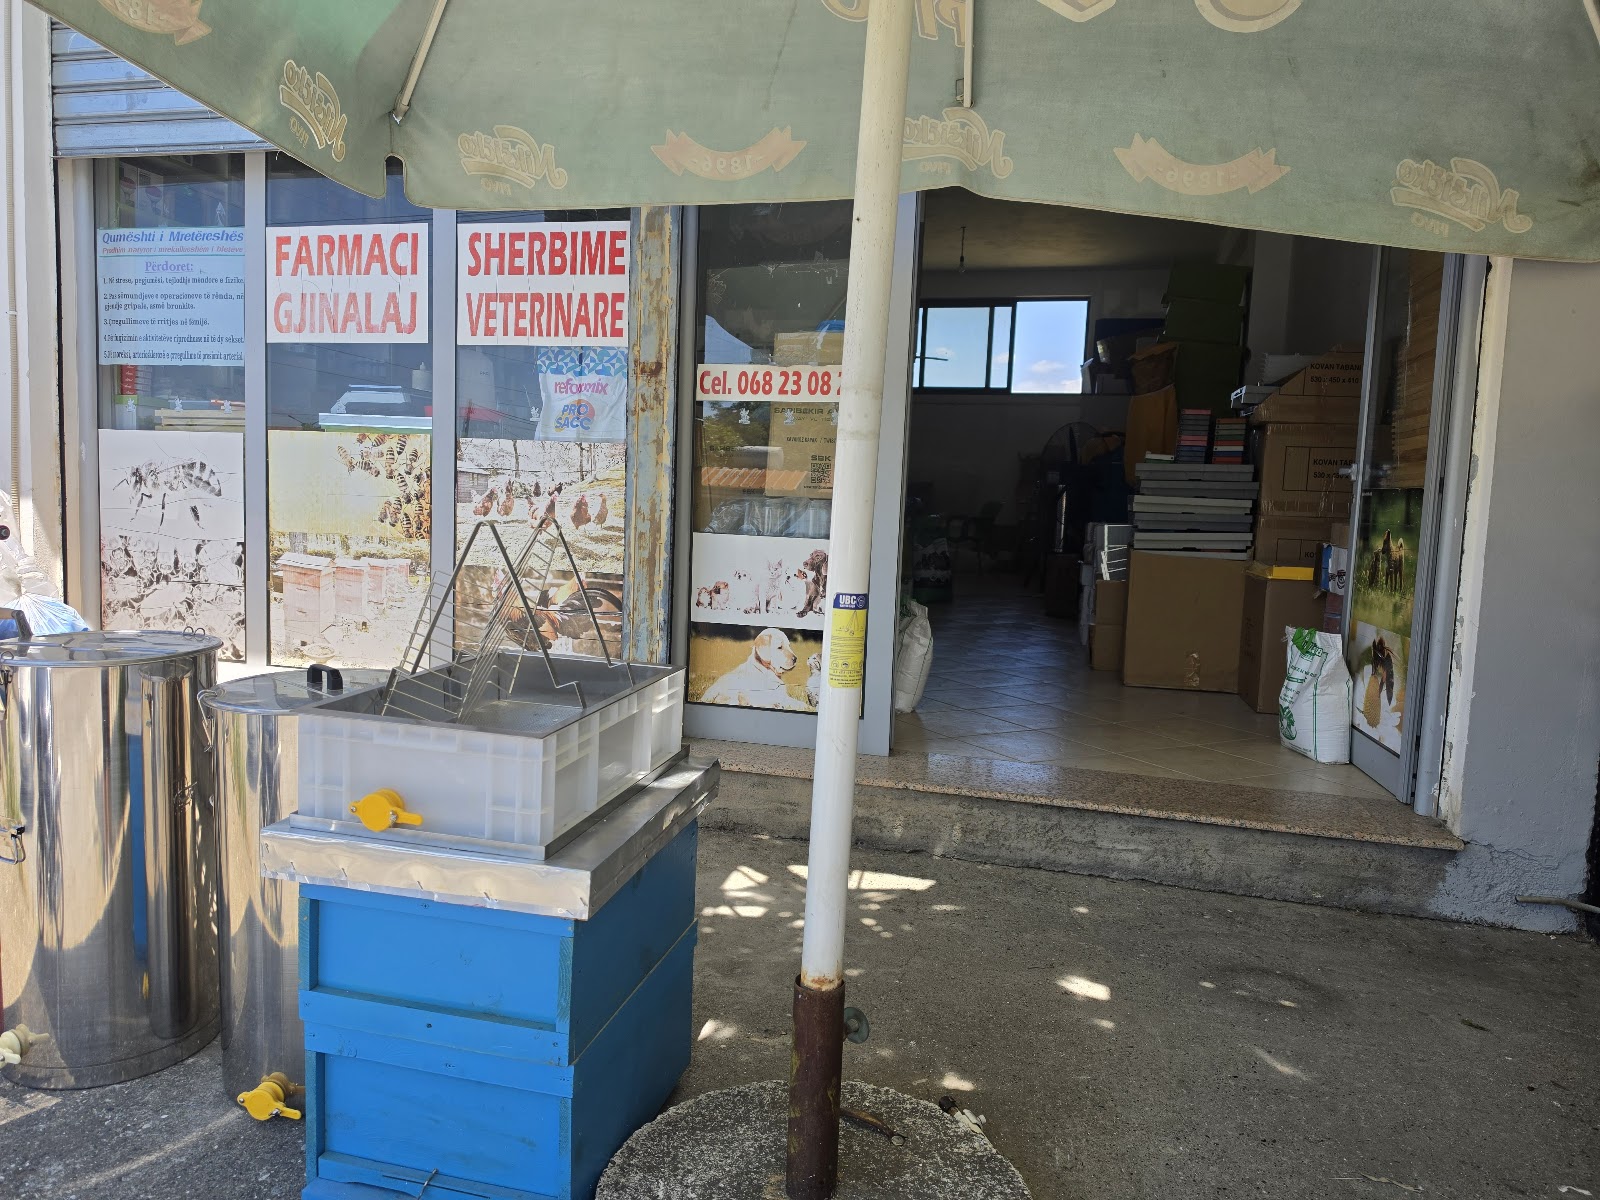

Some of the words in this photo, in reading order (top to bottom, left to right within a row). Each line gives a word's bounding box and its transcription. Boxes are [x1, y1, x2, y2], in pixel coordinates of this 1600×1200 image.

[102, 231, 155, 244] Qumështi
[168, 230, 244, 242] Mretëreshës
[274, 232, 419, 277] FARMACI
[467, 230, 628, 277] SHERBIME
[144, 261, 194, 272] Përdoret:
[273, 291, 418, 335] GJINALAJ
[466, 292, 626, 338] VETERINARE
[699, 370, 732, 395] Cel.
[737, 370, 773, 396] 068
[778, 370, 802, 396] 23
[807, 370, 832, 396] 08
[561, 403, 590, 416] PRO
[554, 416, 592, 431] SACC
[839, 594, 857, 605] UBC
